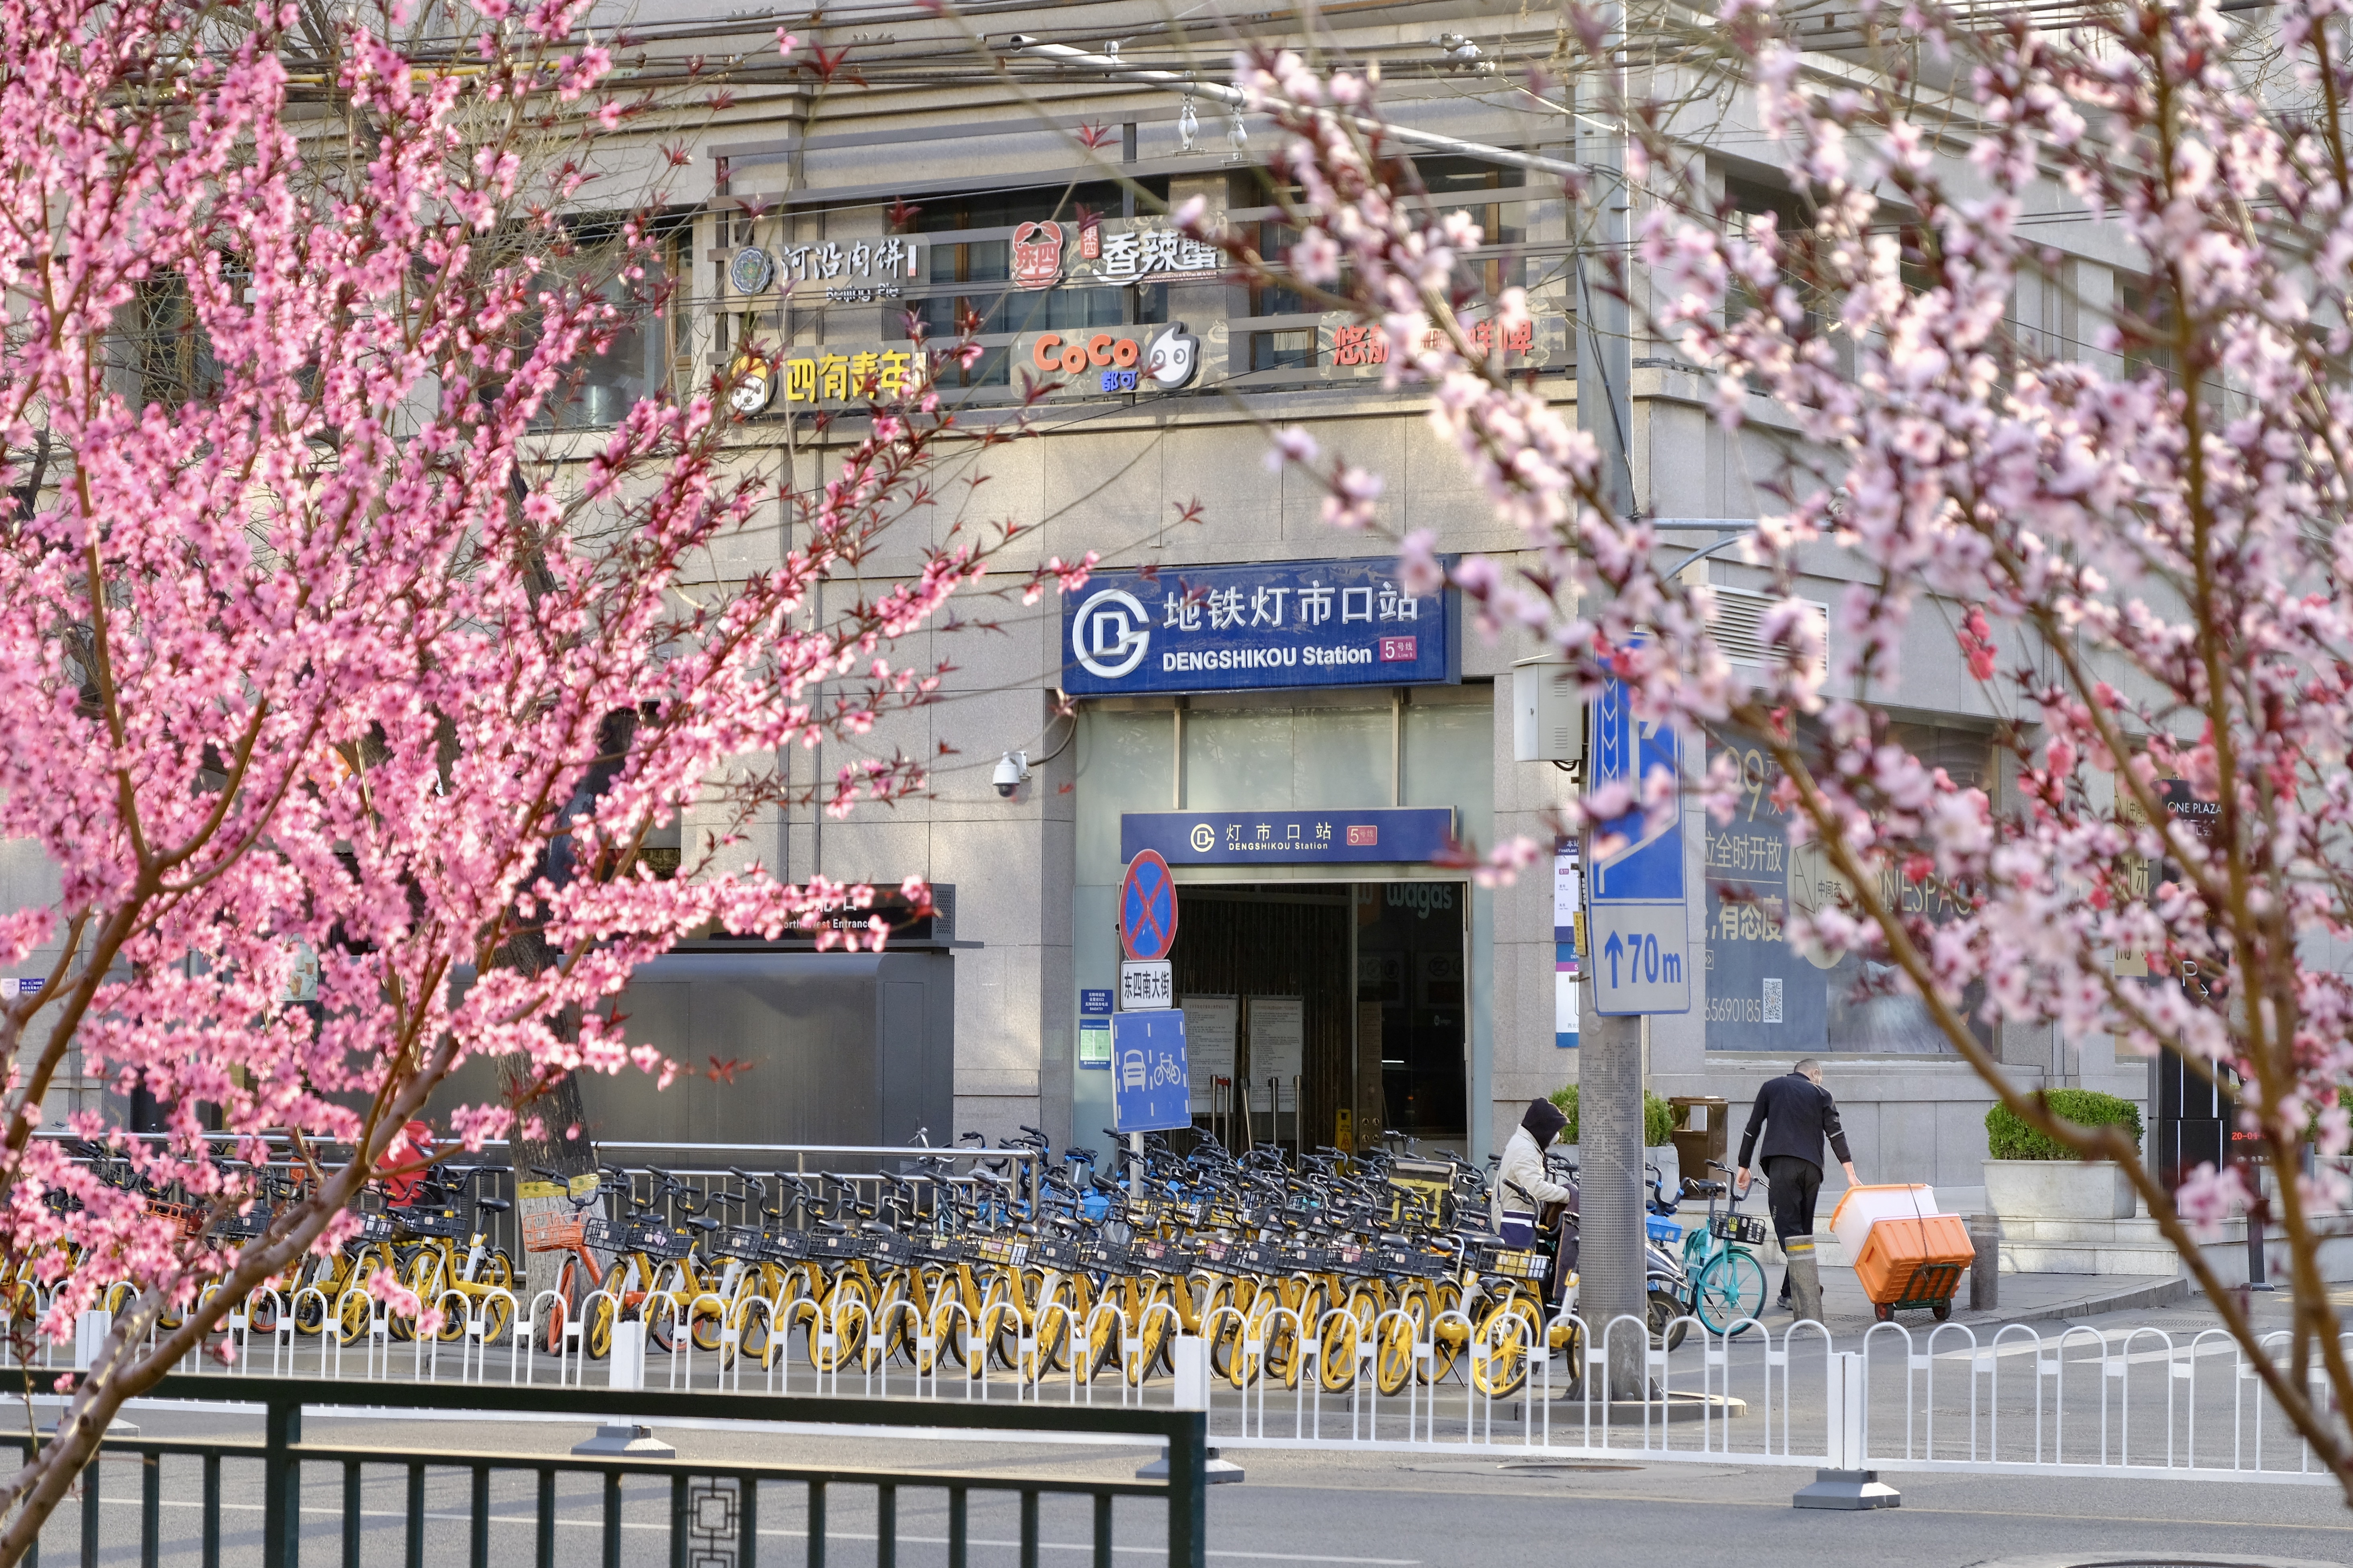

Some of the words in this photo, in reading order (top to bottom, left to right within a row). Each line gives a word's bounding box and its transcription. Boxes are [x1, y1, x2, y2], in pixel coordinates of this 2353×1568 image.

[780, 237, 905, 280] 河沿肉饼
[877, 282, 899, 297] Pie
[1033, 334, 1138, 374] CoCo
[787, 349, 912, 403] 四有青年
[1100, 370, 1138, 391] 都可
[1163, 580, 1418, 631] 地铁灯市口站
[1163, 648, 1297, 671] DENGSHIKOU
[1303, 645, 1372, 666] Station
[1385, 641, 1395, 659] 5
[1397, 642, 1413, 651] 号线
[2167, 801, 2190, 813] ONE
[2193, 802, 2223, 814] PLAZA
[1226, 822, 1332, 841] 灯市口站
[1228, 842, 1290, 851] DENGSHIKOU
[1818, 880, 1841, 898] 中间态
[1387, 883, 1453, 920] wagas
[783, 919, 801, 929] orth
[833, 918, 871, 929] Entrance
[1124, 970, 1169, 999] 东四南大街
